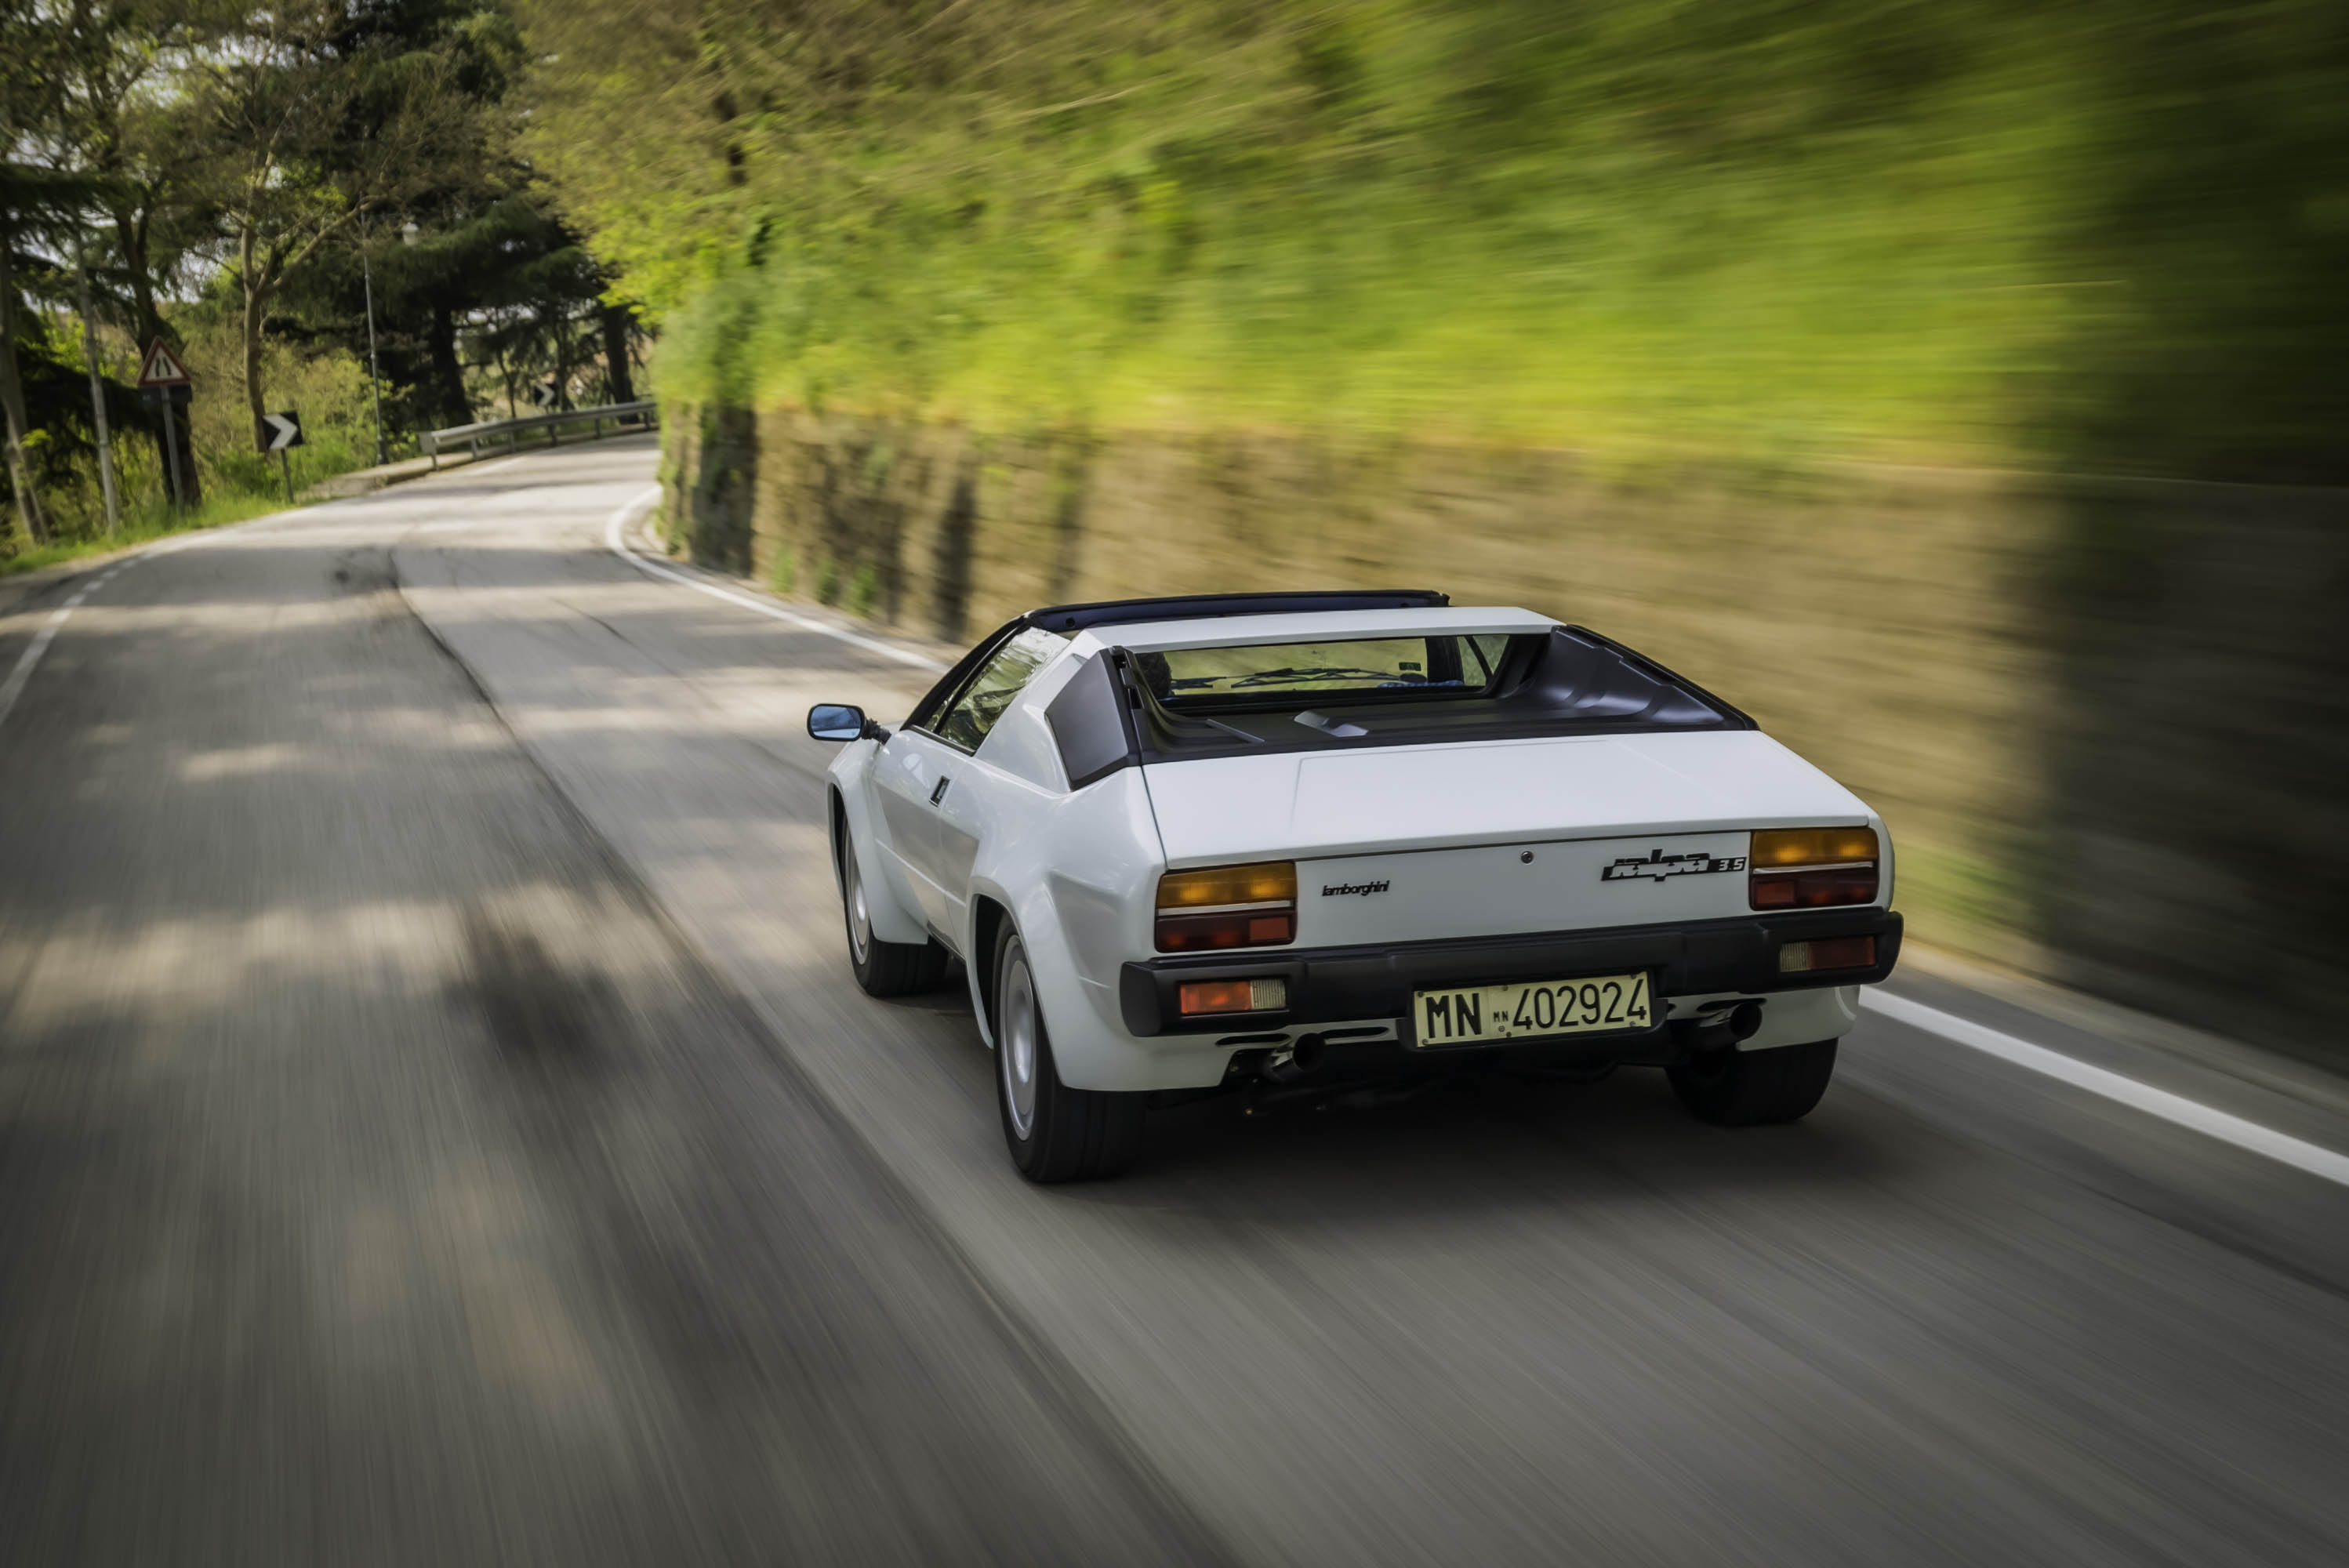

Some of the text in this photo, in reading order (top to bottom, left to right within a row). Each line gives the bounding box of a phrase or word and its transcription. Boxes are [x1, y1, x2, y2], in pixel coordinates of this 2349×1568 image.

[1718, 858, 1745, 871] 3.5
[1425, 978, 1646, 1038] MN MN 402924
